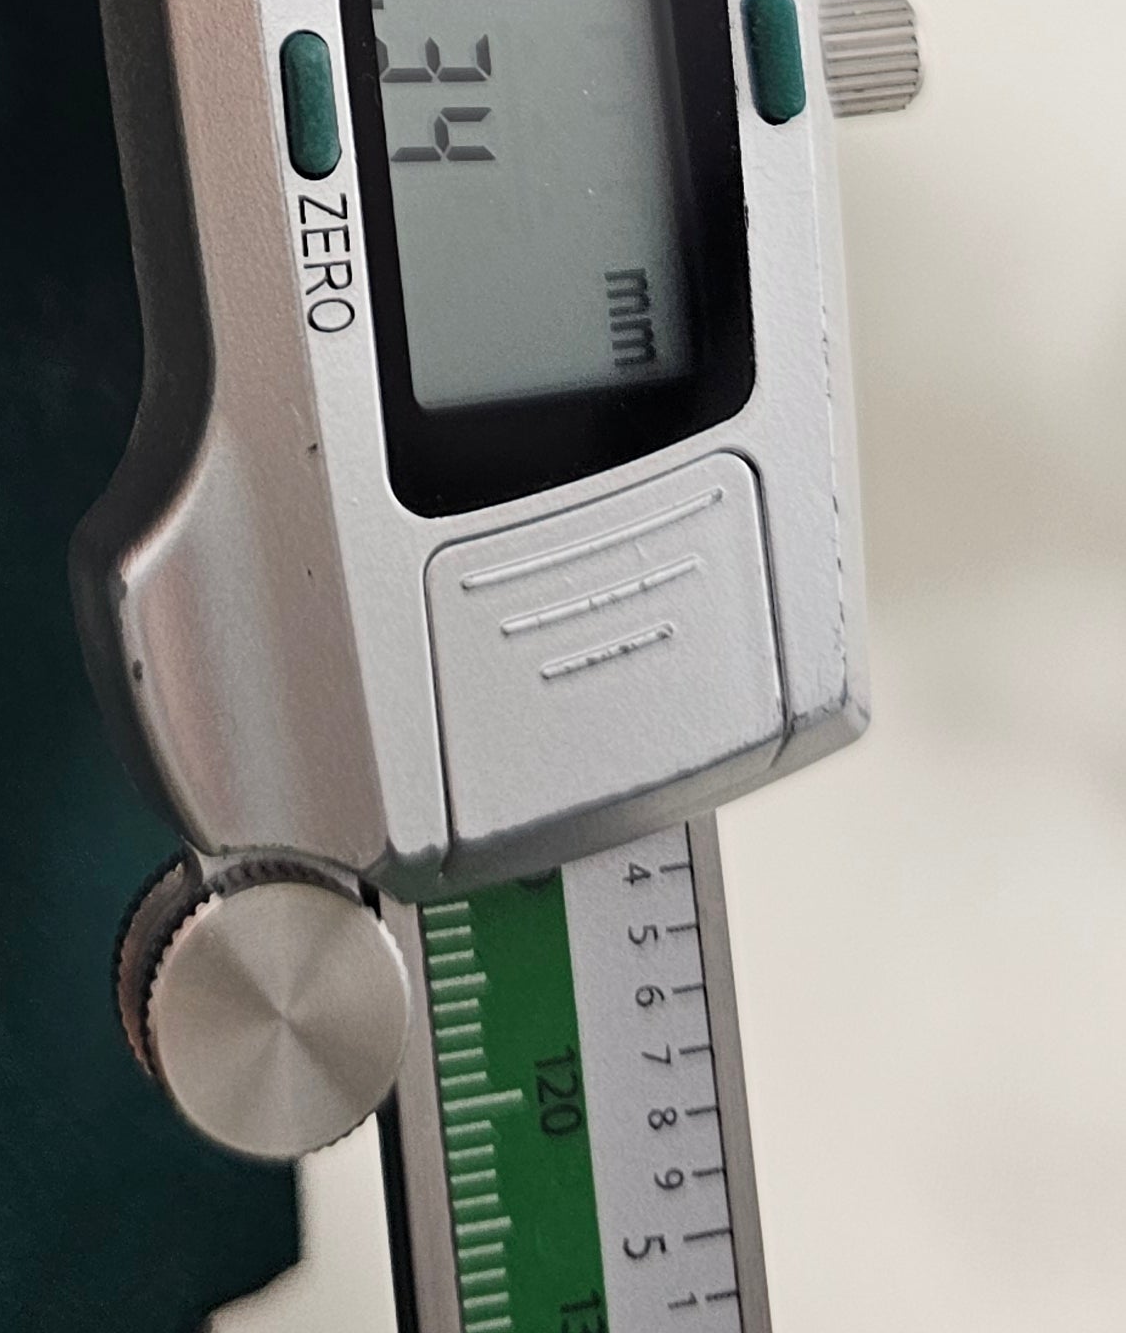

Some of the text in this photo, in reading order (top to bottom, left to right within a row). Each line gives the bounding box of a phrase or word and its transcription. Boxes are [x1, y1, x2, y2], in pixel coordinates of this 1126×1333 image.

[298, 191, 355, 334] ZERO
[604, 267, 657, 368] mm
[623, 863, 651, 885] 4
[628, 926, 659, 946] 5
[635, 987, 665, 1008] 6
[642, 1045, 671, 1066] 7
[534, 1045, 583, 1137] 120
[647, 1108, 678, 1130] 8
[654, 1169, 684, 1191] 9
[623, 1235, 667, 1260] 5
[667, 1293, 698, 1310] 1
